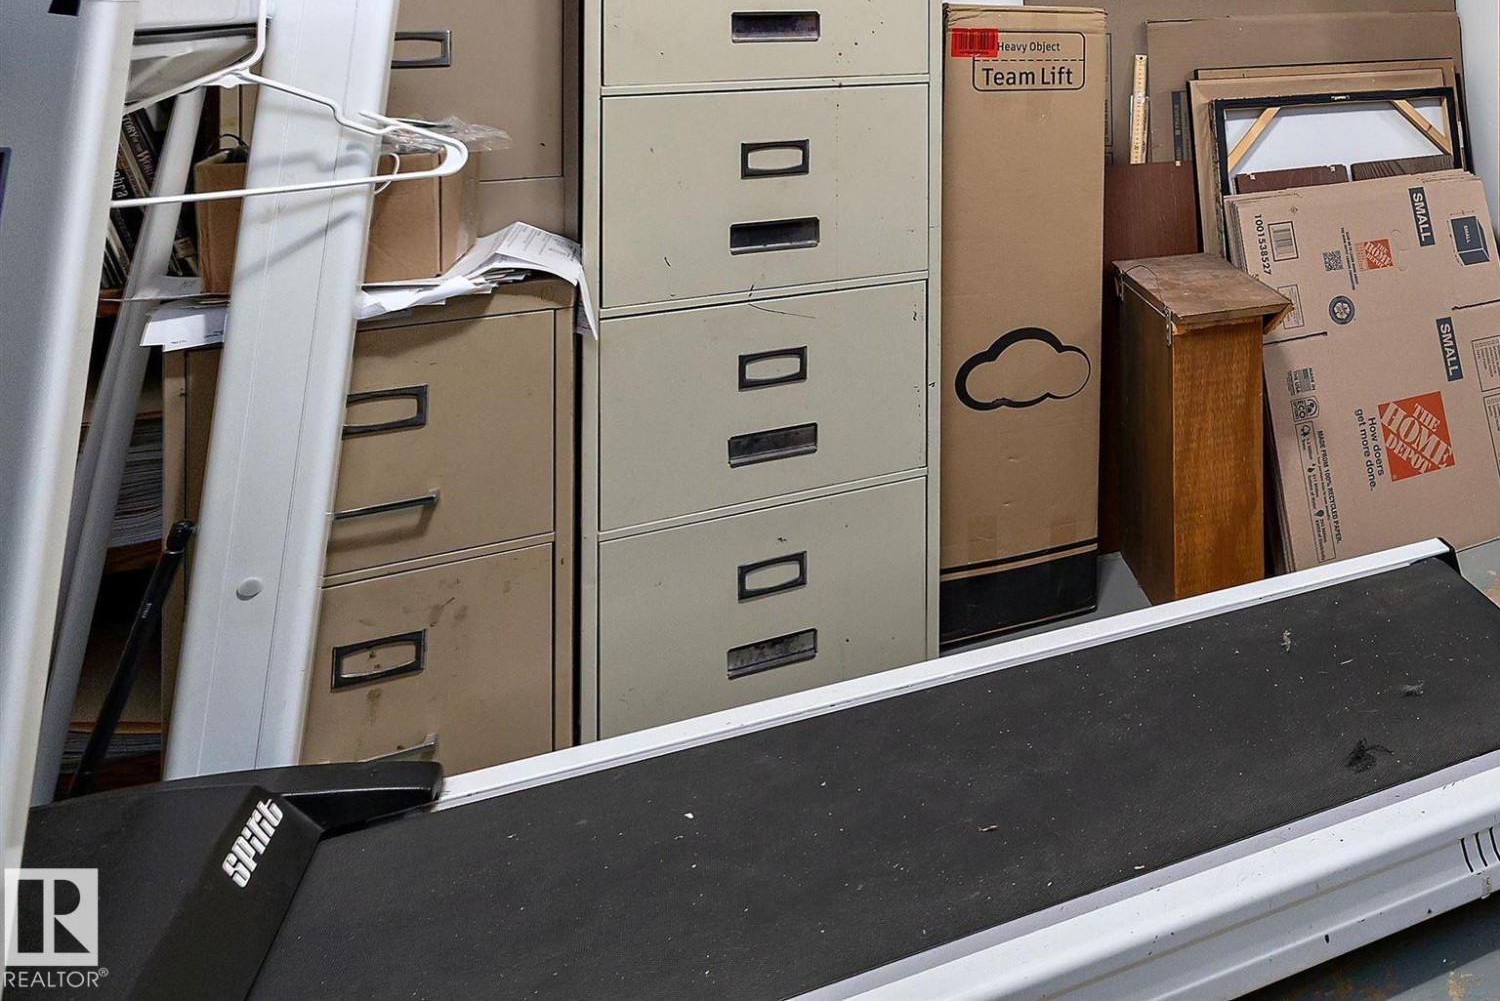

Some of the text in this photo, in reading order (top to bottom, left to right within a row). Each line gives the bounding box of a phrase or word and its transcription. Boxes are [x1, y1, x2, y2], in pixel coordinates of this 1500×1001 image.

[997, 41, 1061, 54] Heavy Object
[982, 66, 1073, 86] Team Lift
[1412, 192, 1431, 242] SMALL
[1254, 214, 1272, 276] 1001538527
[1463, 224, 1472, 244] SMALL
[1440, 323, 1459, 377] SMALL
[1297, 400, 1306, 419] ECO
[1412, 403, 1440, 432] THE
[1317, 430, 1326, 448] MADE
[1354, 408, 1377, 491] get more done.
[1368, 417, 1385, 476] How doers
[1380, 402, 1452, 468] HOME
[1320, 449, 1329, 468] FROM
[1386, 432, 1432, 474] DEPOT
[1324, 469, 1333, 487] 100%
[1327, 487, 1338, 520] RECYCLED
